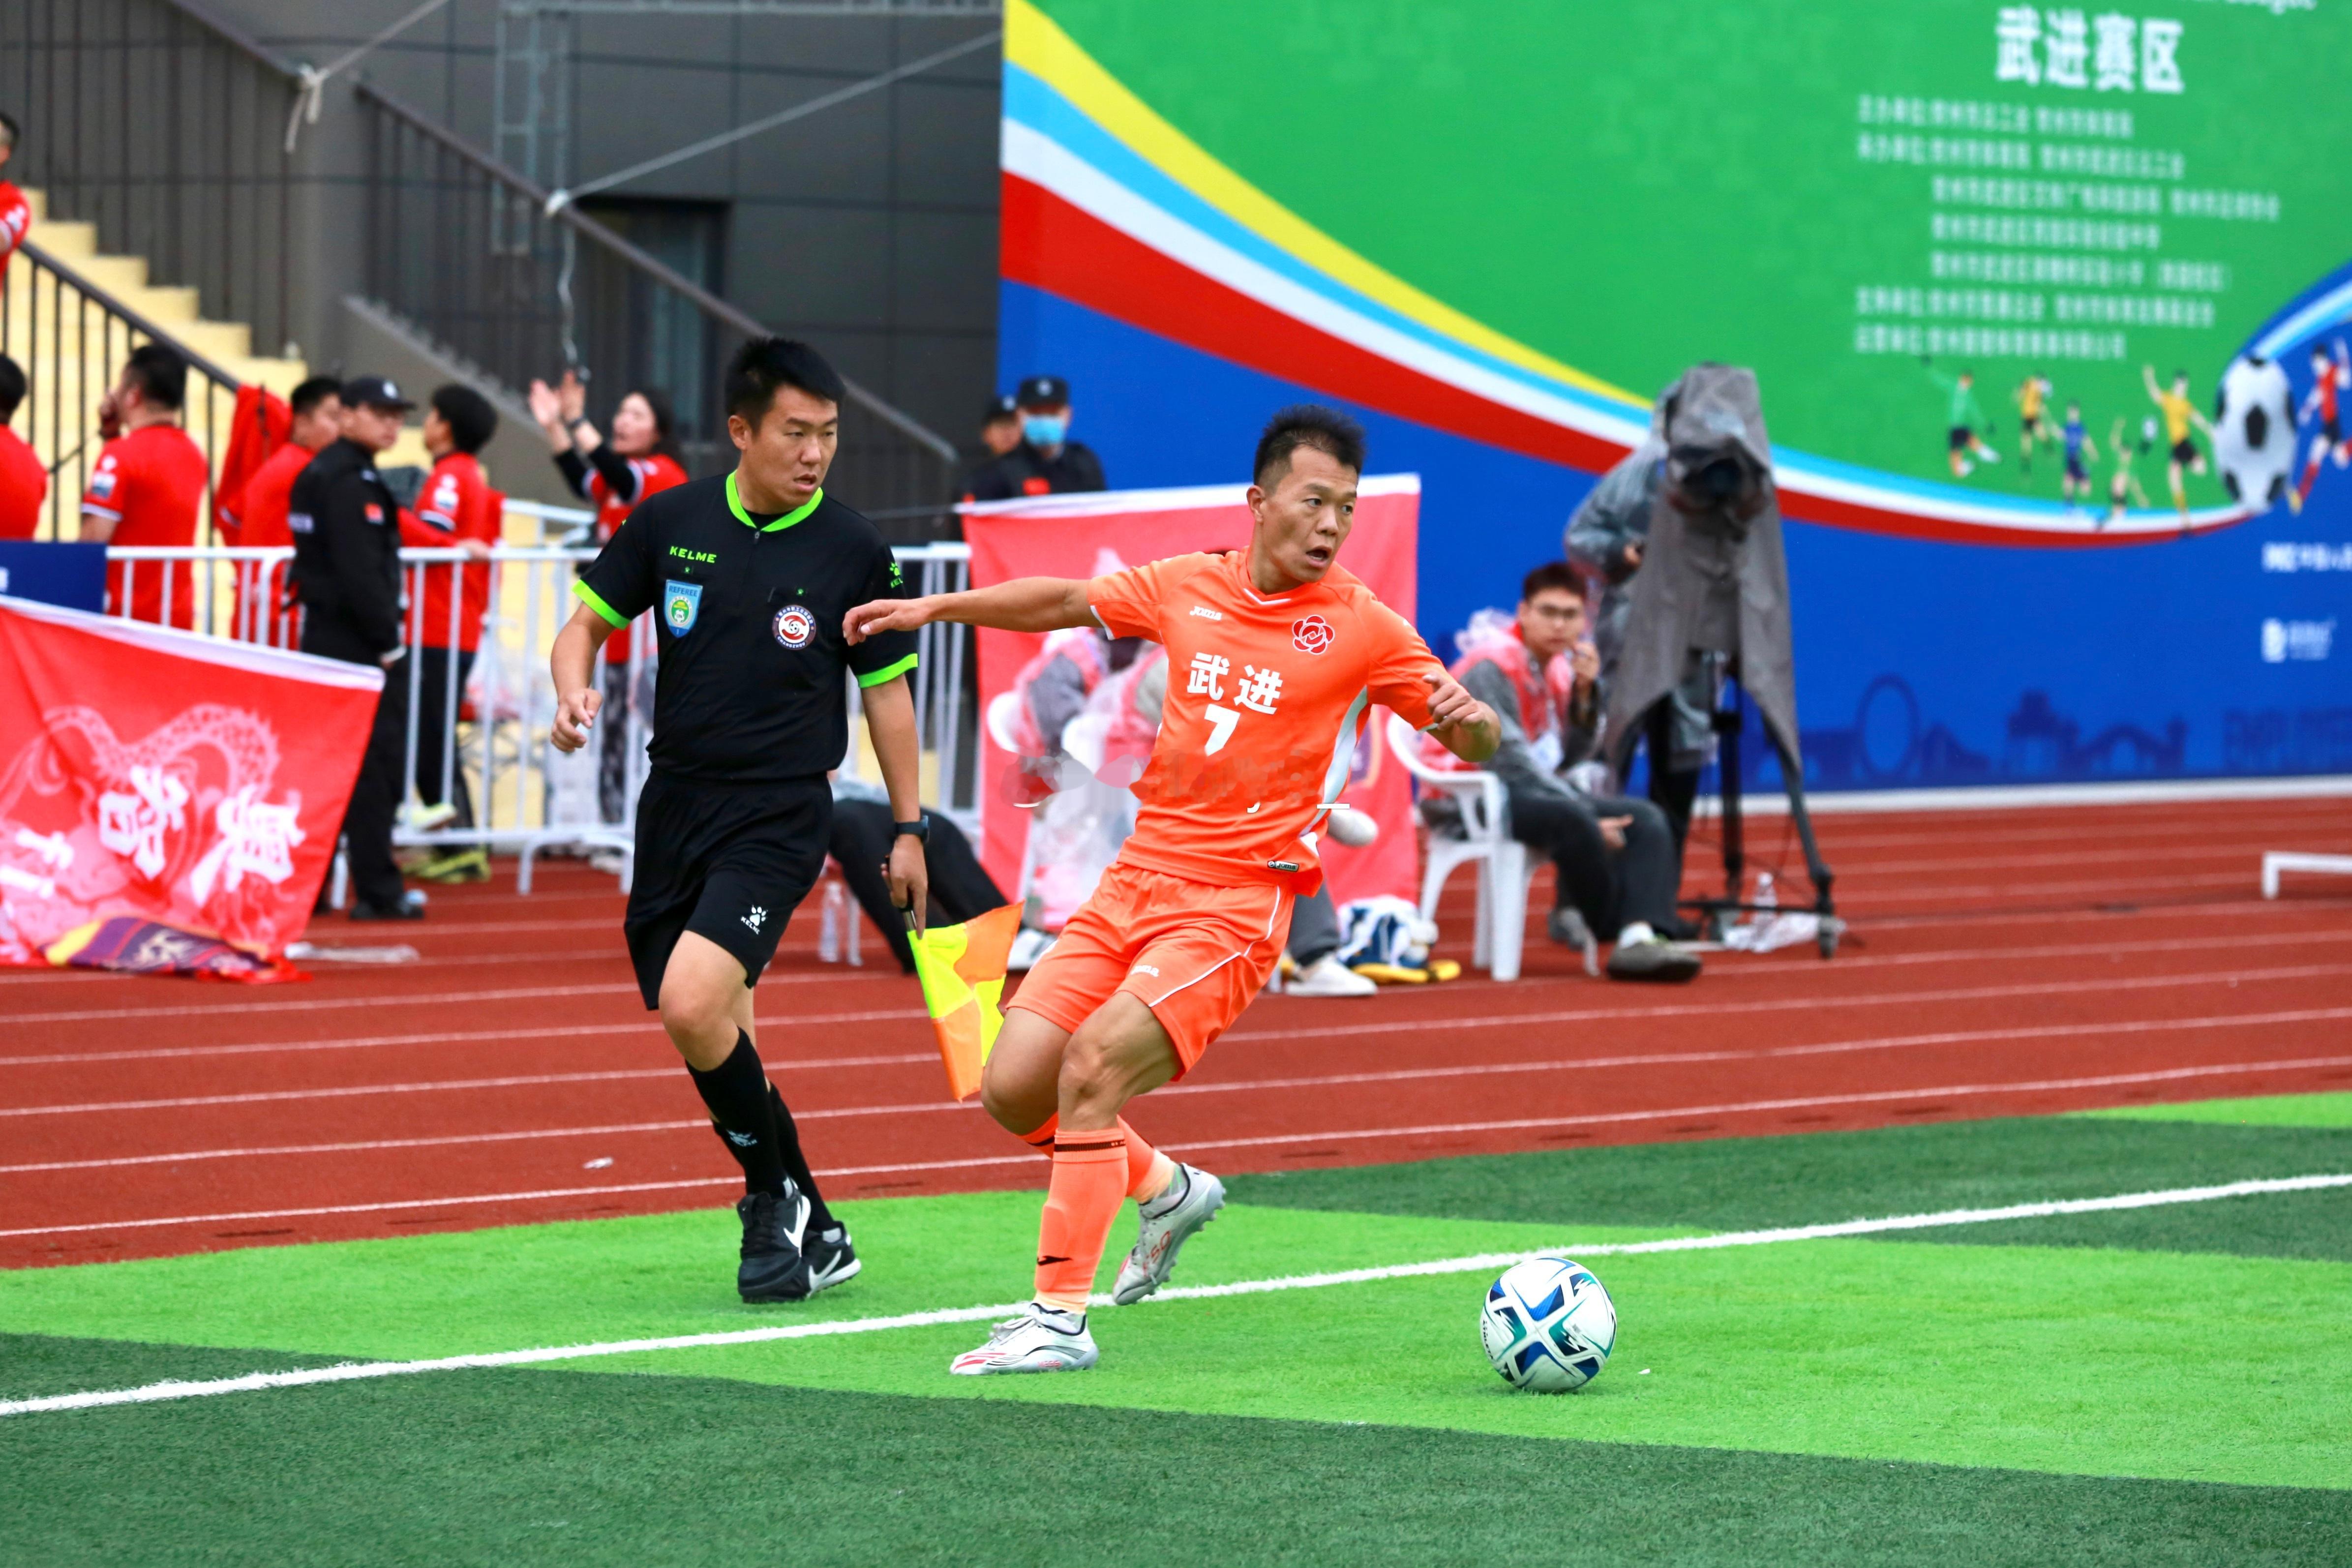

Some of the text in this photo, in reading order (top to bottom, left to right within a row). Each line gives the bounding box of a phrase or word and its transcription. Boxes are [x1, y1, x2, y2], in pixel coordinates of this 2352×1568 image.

[669, 546, 717, 563] KELME
[669, 585, 697, 597] REFEREE
[1187, 652, 1283, 715] 武进
[1204, 703, 1241, 757] 7
